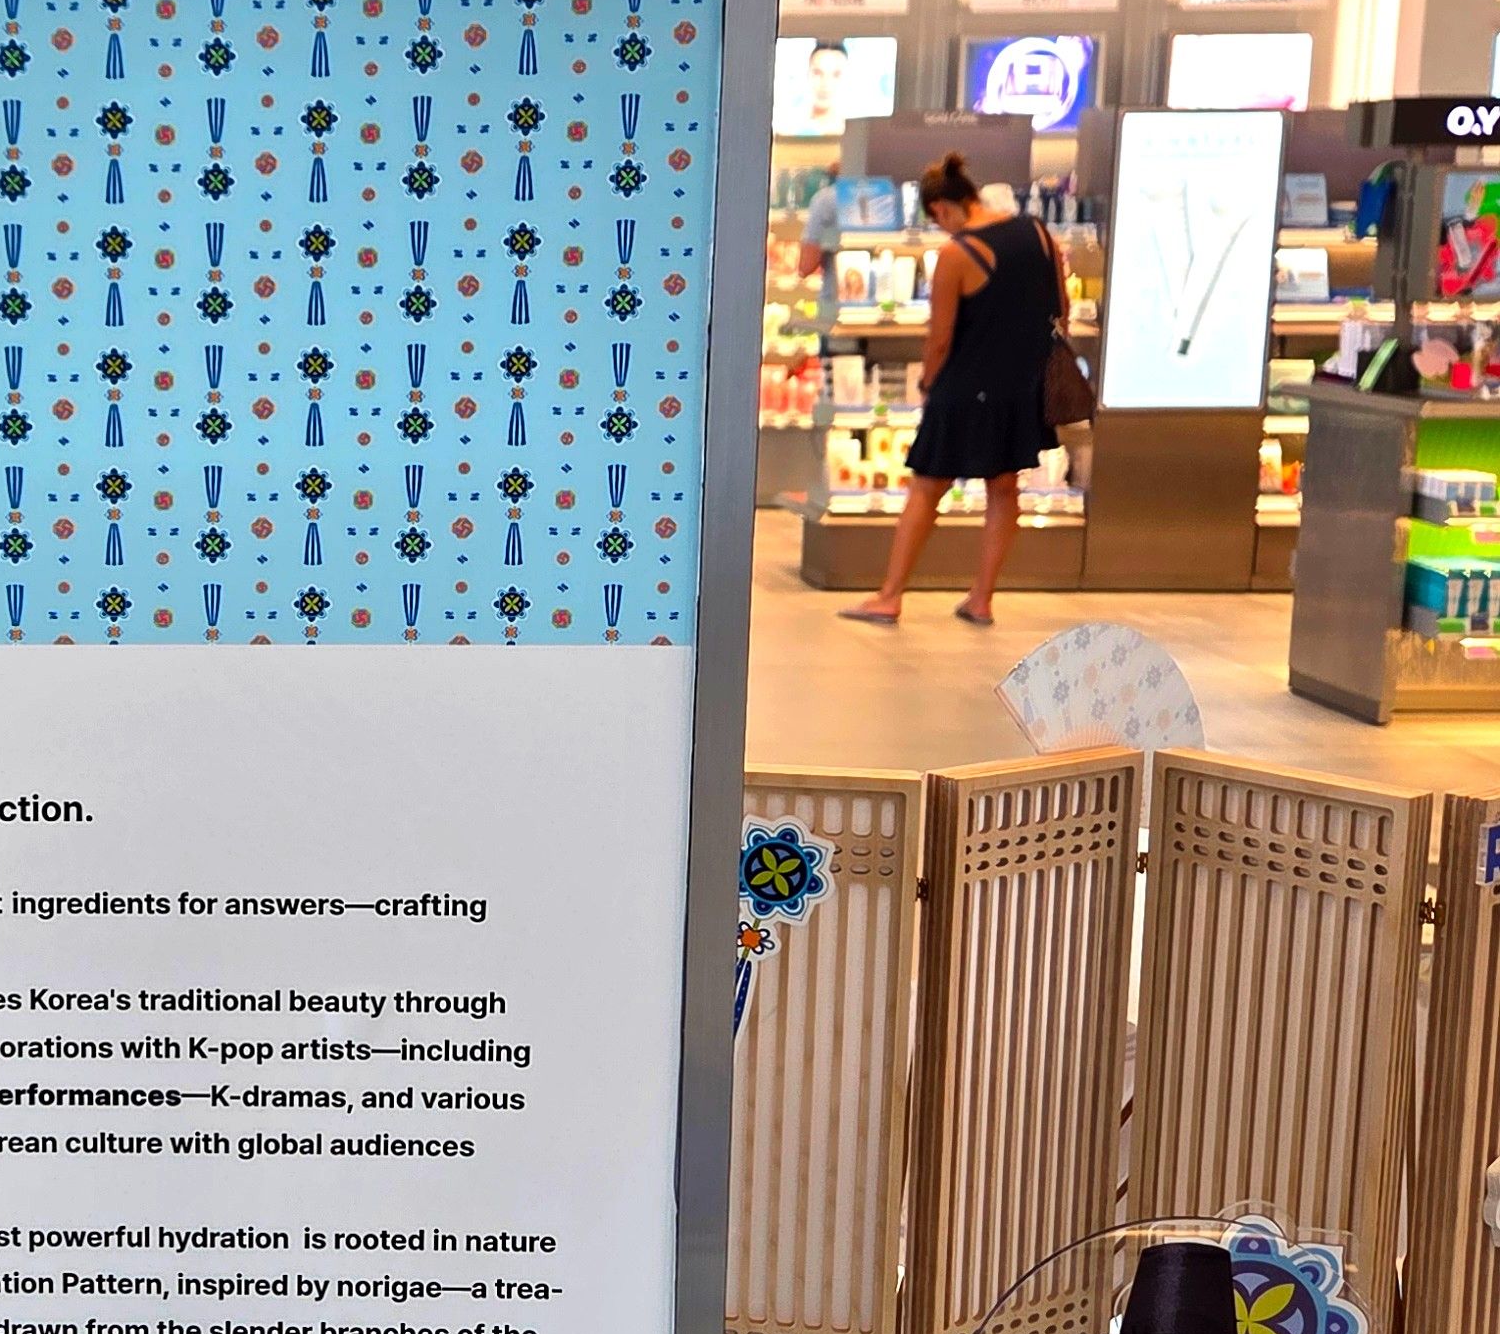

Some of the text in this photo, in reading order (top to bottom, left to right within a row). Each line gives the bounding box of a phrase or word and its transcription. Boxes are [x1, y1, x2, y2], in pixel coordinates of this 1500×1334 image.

[11, 890, 172, 921] ingredients
[177, 891, 219, 916] for
[29, 987, 132, 1012] Korea's
[137, 987, 282, 1013] traditional
[288, 989, 388, 1019] beauty
[392, 990, 506, 1020] through
[360, 1086, 414, 1110] and
[420, 1085, 526, 1111] various
